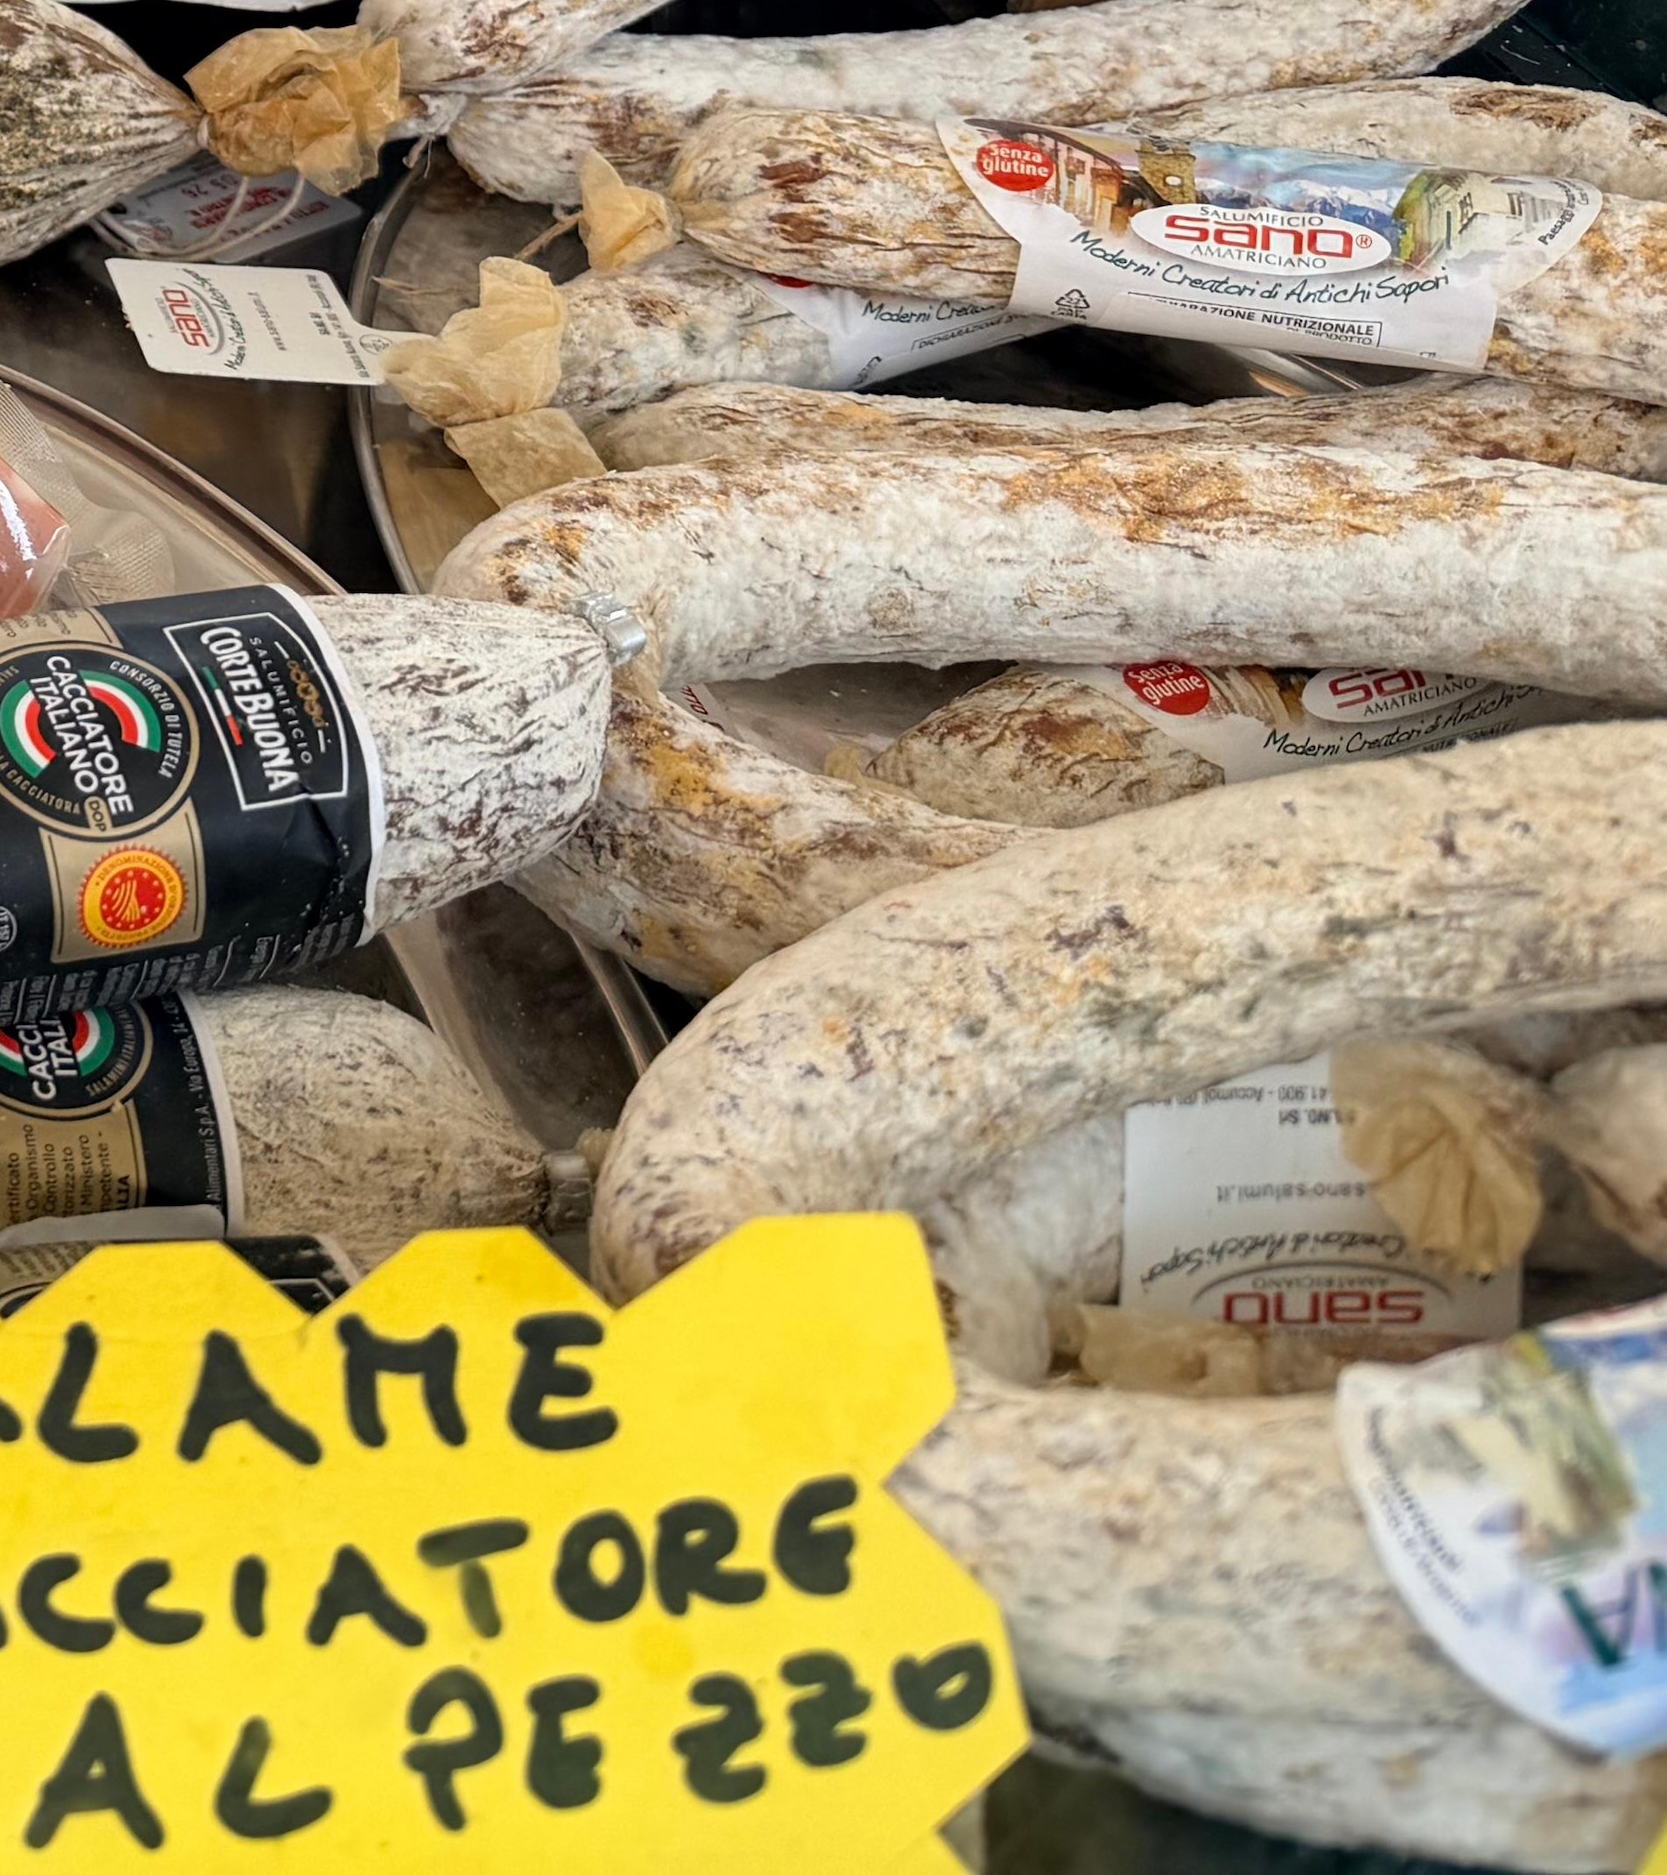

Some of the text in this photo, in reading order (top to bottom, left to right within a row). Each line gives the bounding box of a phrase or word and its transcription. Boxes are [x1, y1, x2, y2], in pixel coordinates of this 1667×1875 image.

[981, 156, 1050, 177] glutine
[989, 138, 1043, 164] Senza
[1163, 213, 1354, 259] sano
[1199, 204, 1324, 229] SALUMIFICIO
[1069, 229, 1450, 305] Moderni Creatori di Antichi Sapori
[1190, 243, 1328, 270] AMATRICIANO
[162, 289, 210, 348] sano
[862, 301, 932, 325] Moderni
[1260, 312, 1375, 338] NUTRIZIONALE
[250, 635, 314, 766] SALUMIFICIO
[1141, 674, 1204, 707] glutine
[1363, 674, 1478, 717] AMATRICIANO
[28, 675, 99, 794] ITALIANO
[45, 654, 135, 816] CACCIATORE
[109, 659, 183, 779] CONSORZIO DI TUTELA
[1262, 727, 1343, 757] Moderni
[1345, 722, 1424, 754] Creatori
[5, 768, 82, 816] CACCIATORA
[87, 799, 108, 833] DOP
[7, 1151, 21, 1229] ertificato
[24, 1123, 41, 1211] Organismo
[42, 1143, 56, 1215] Controllo
[78, 1133, 92, 1206] Ministero
[201, 1137, 222, 1202] Alimentari
[1223, 1290, 1425, 1325] sano
[23, 1692, 333, 1851] AL
